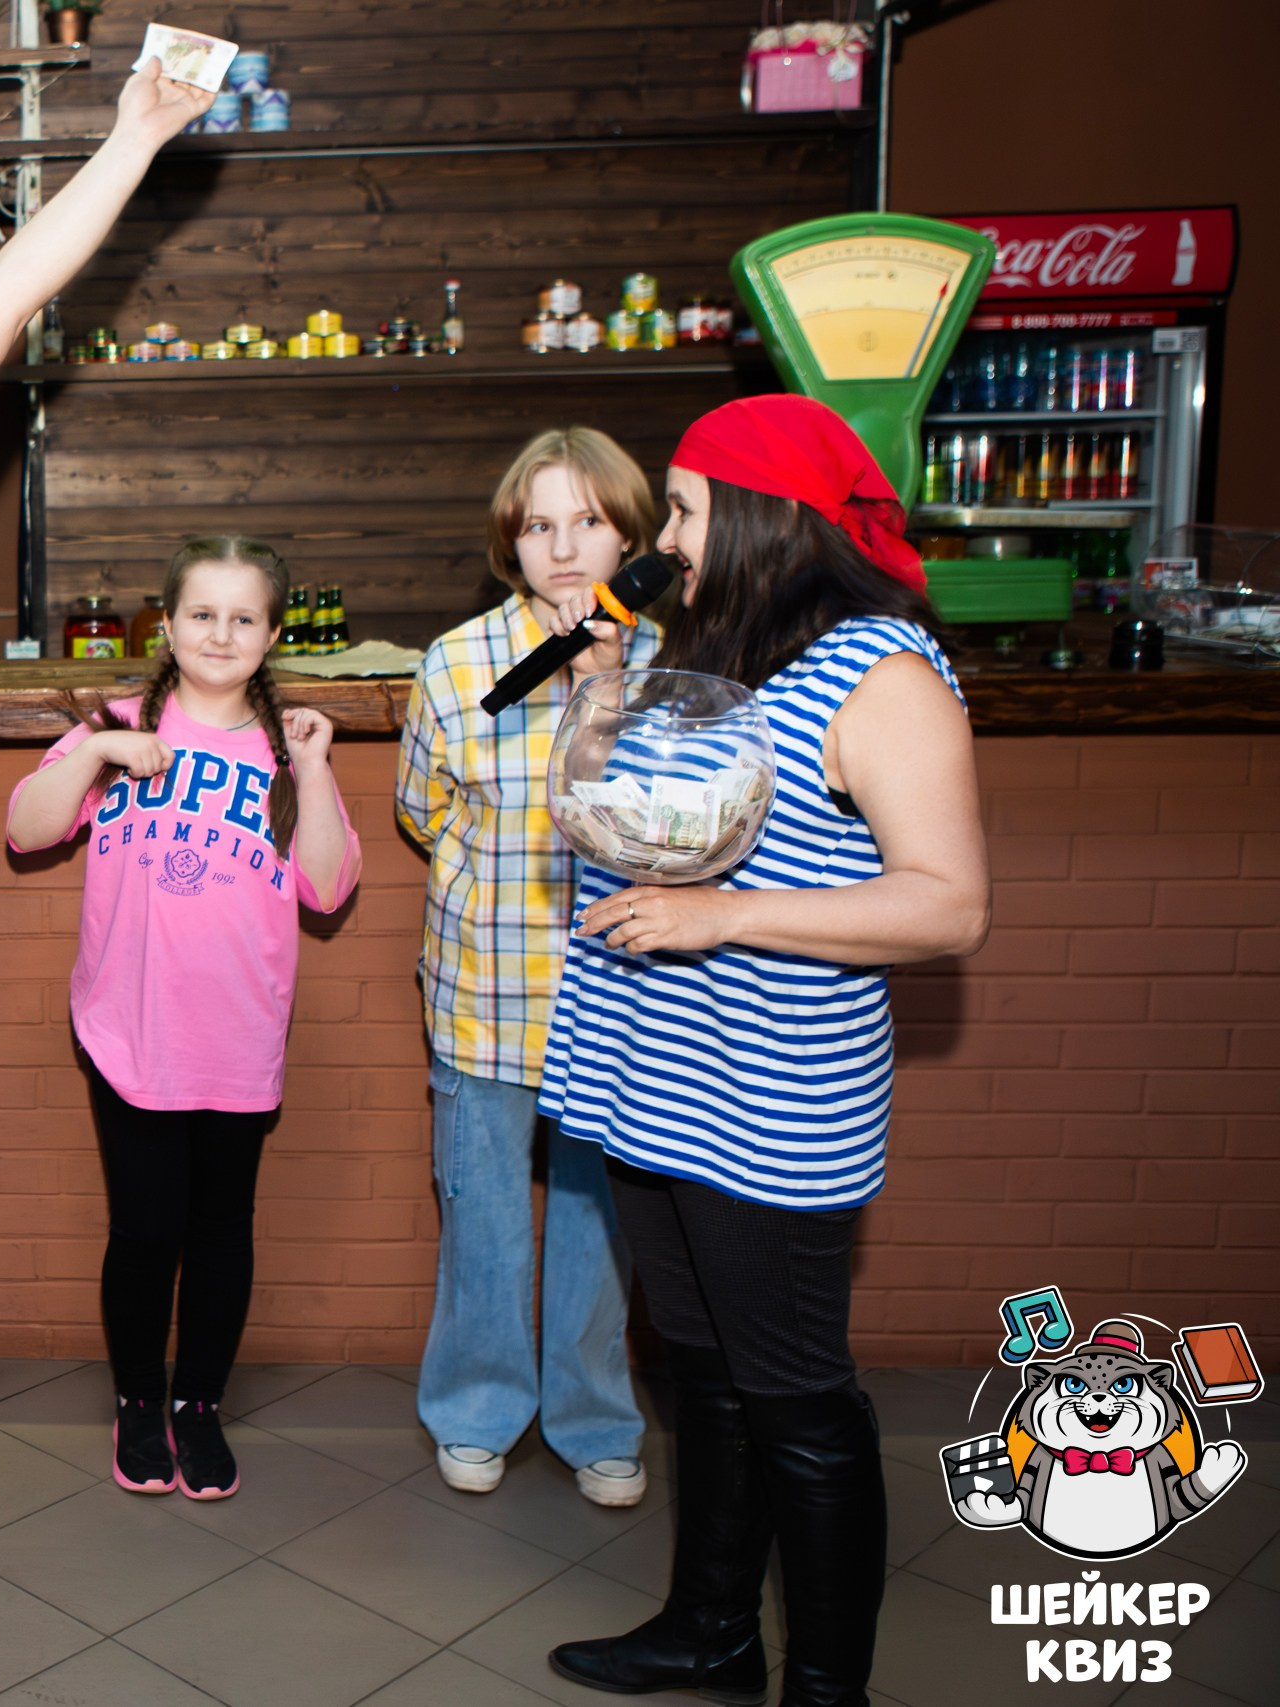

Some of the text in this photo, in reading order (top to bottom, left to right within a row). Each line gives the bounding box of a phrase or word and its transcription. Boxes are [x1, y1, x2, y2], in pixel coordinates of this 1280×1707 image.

[96, 749, 291, 862] SUPE
[98, 820, 285, 890] CHAMPION
[211, 872, 236, 884] 1992
